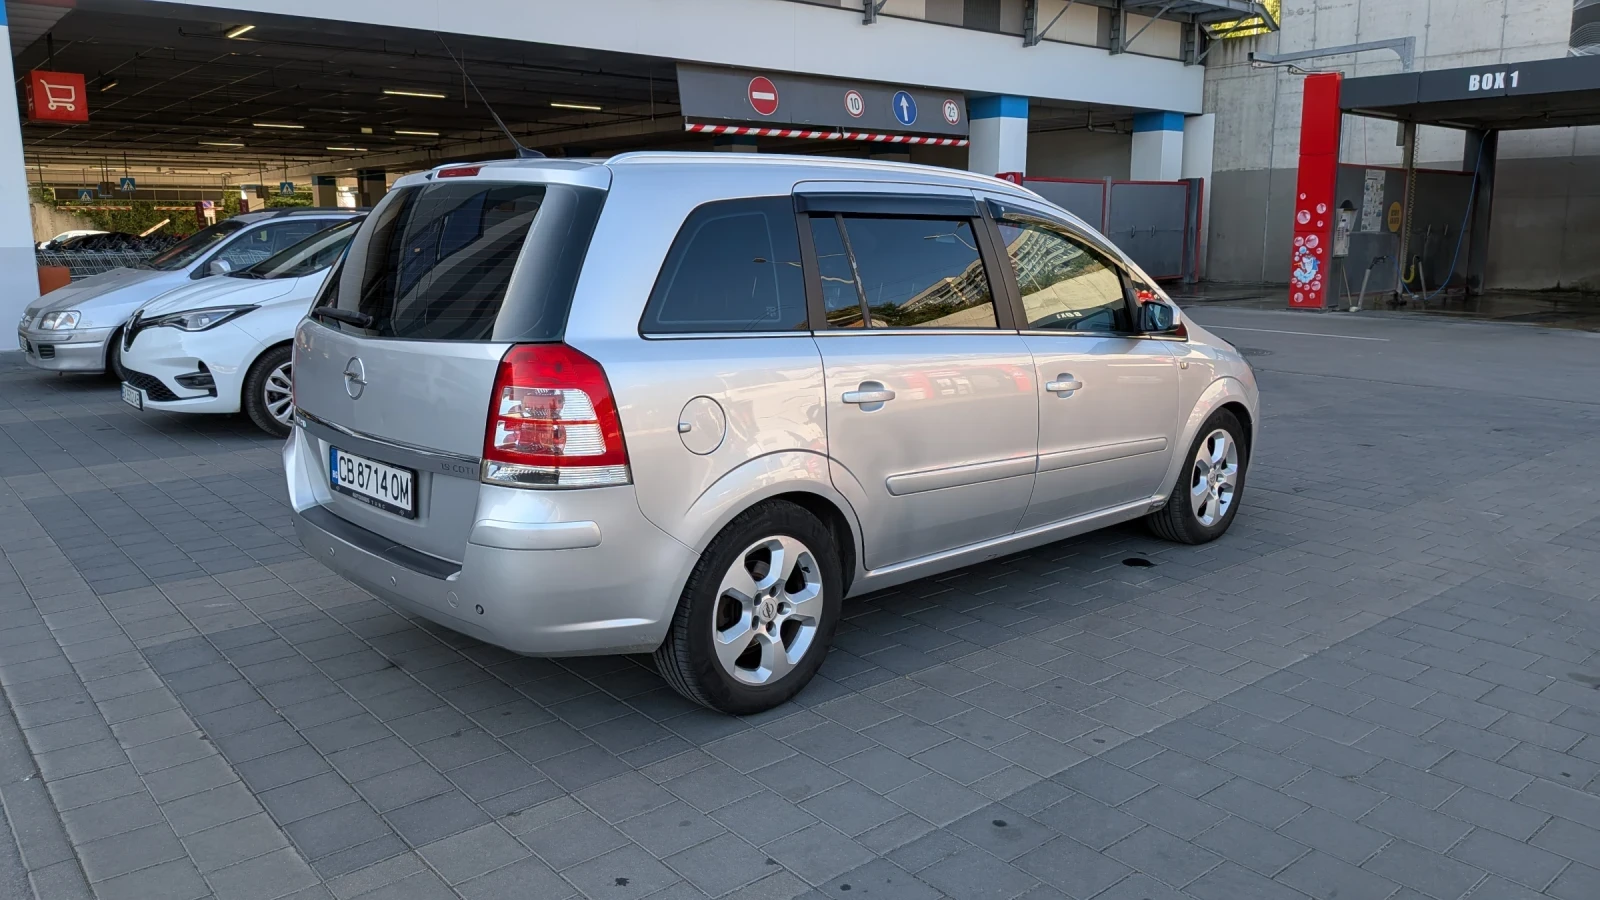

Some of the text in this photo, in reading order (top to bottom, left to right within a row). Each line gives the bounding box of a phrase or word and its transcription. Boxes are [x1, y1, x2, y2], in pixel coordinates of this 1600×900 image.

[1468, 70, 1519, 91] BOX 1
[850, 98, 860, 110] 10
[452, 464, 474, 475] CDTI
[339, 456, 409, 506] CB 8714 OM
